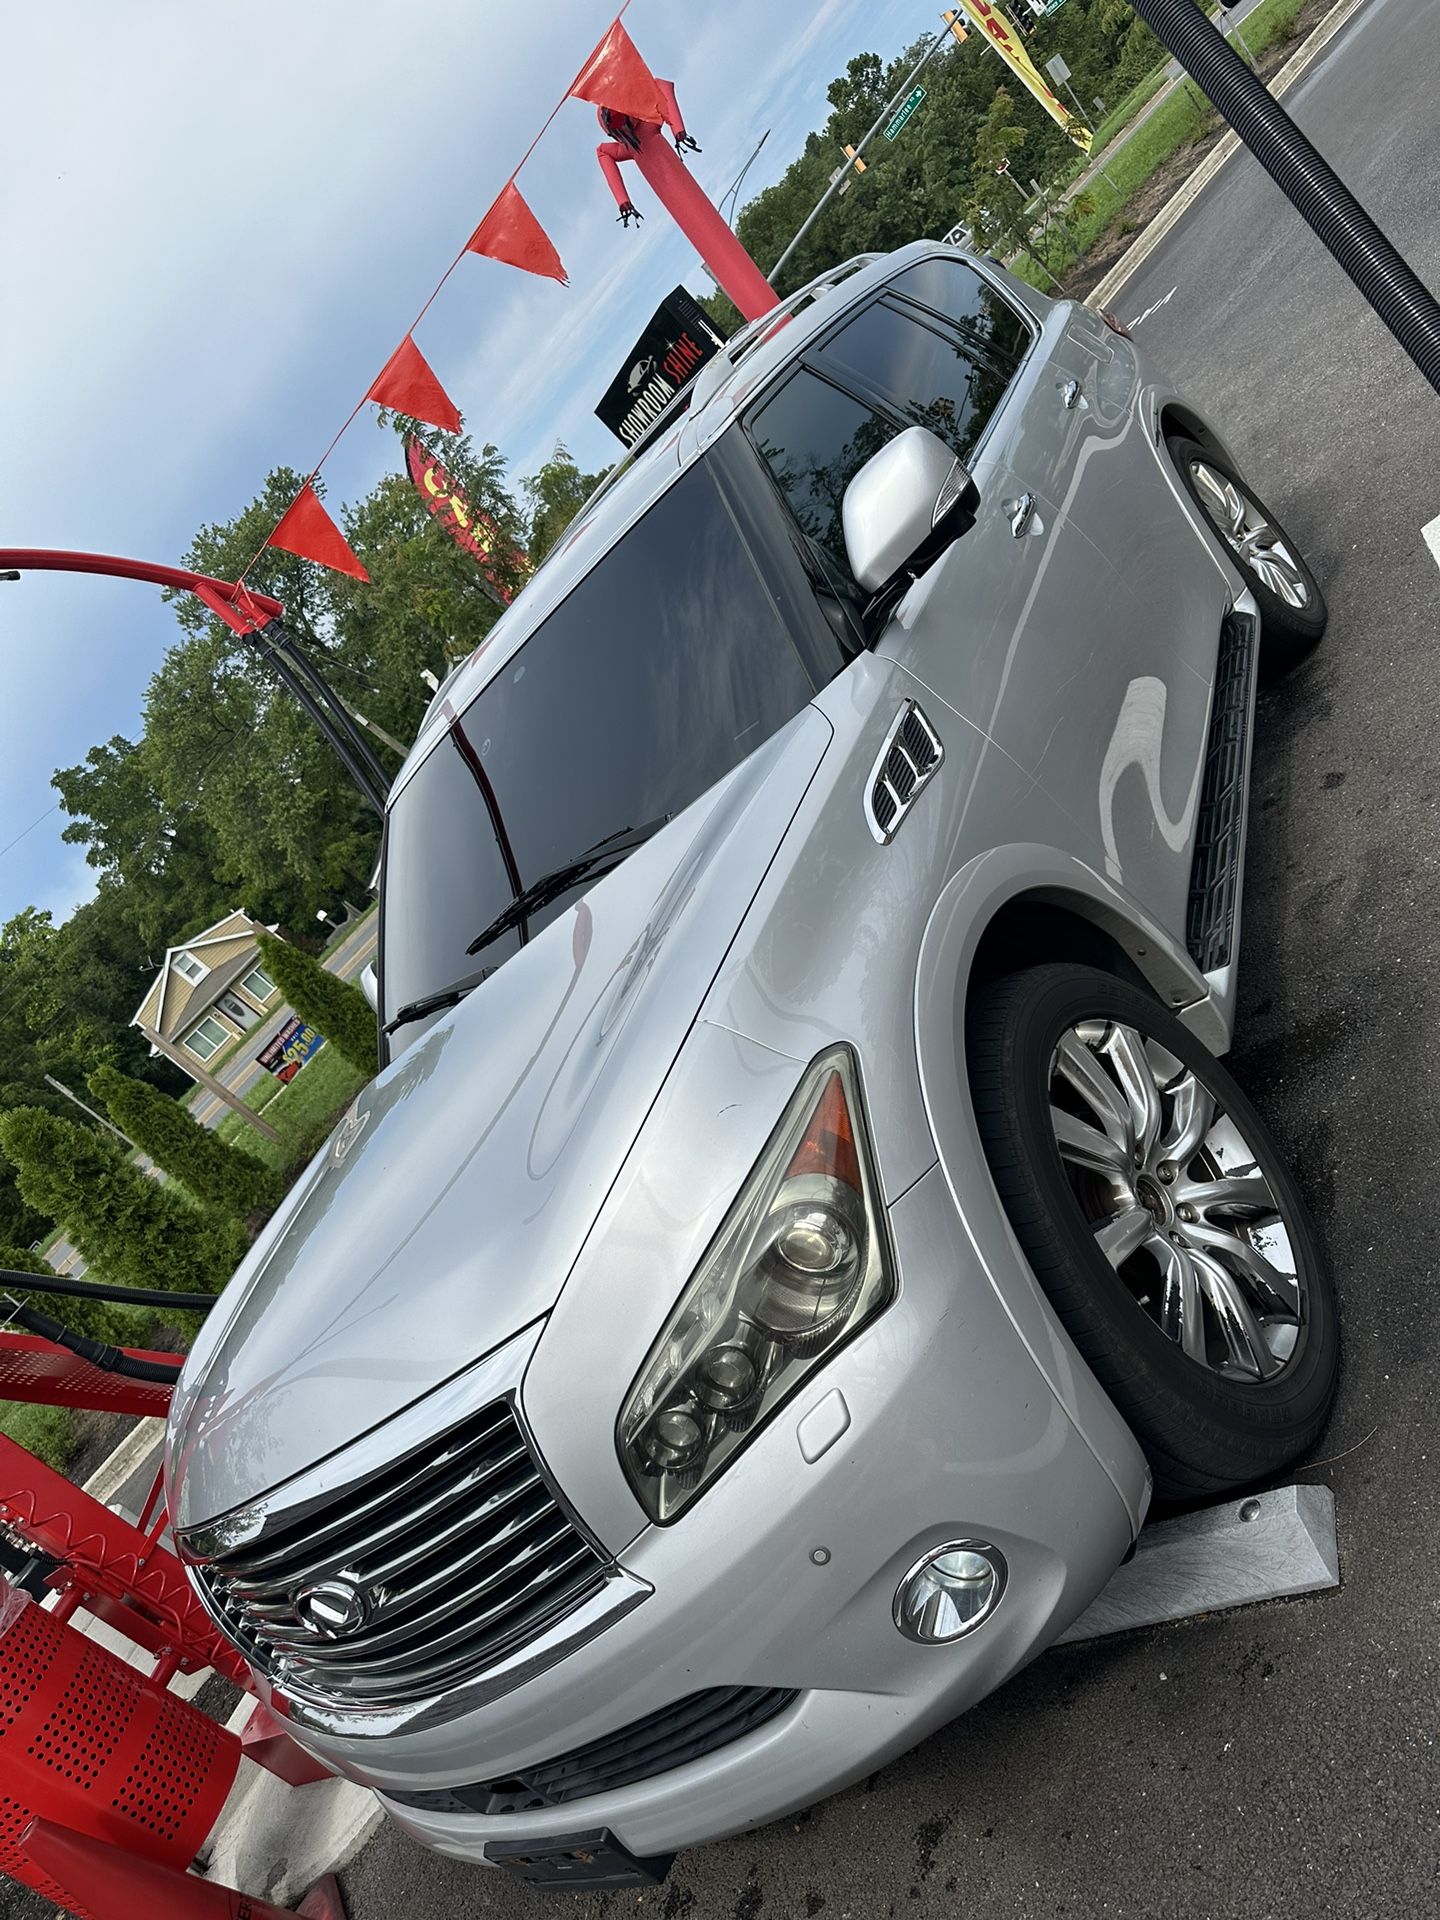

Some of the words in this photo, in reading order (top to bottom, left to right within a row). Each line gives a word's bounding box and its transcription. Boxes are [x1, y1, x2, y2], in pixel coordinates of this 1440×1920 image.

[885, 104, 912, 138] Hammarlee
[619, 372, 675, 444] SHOWROOM
[663, 332, 703, 384] SHINE
[282, 1027, 316, 1065] $25.00
